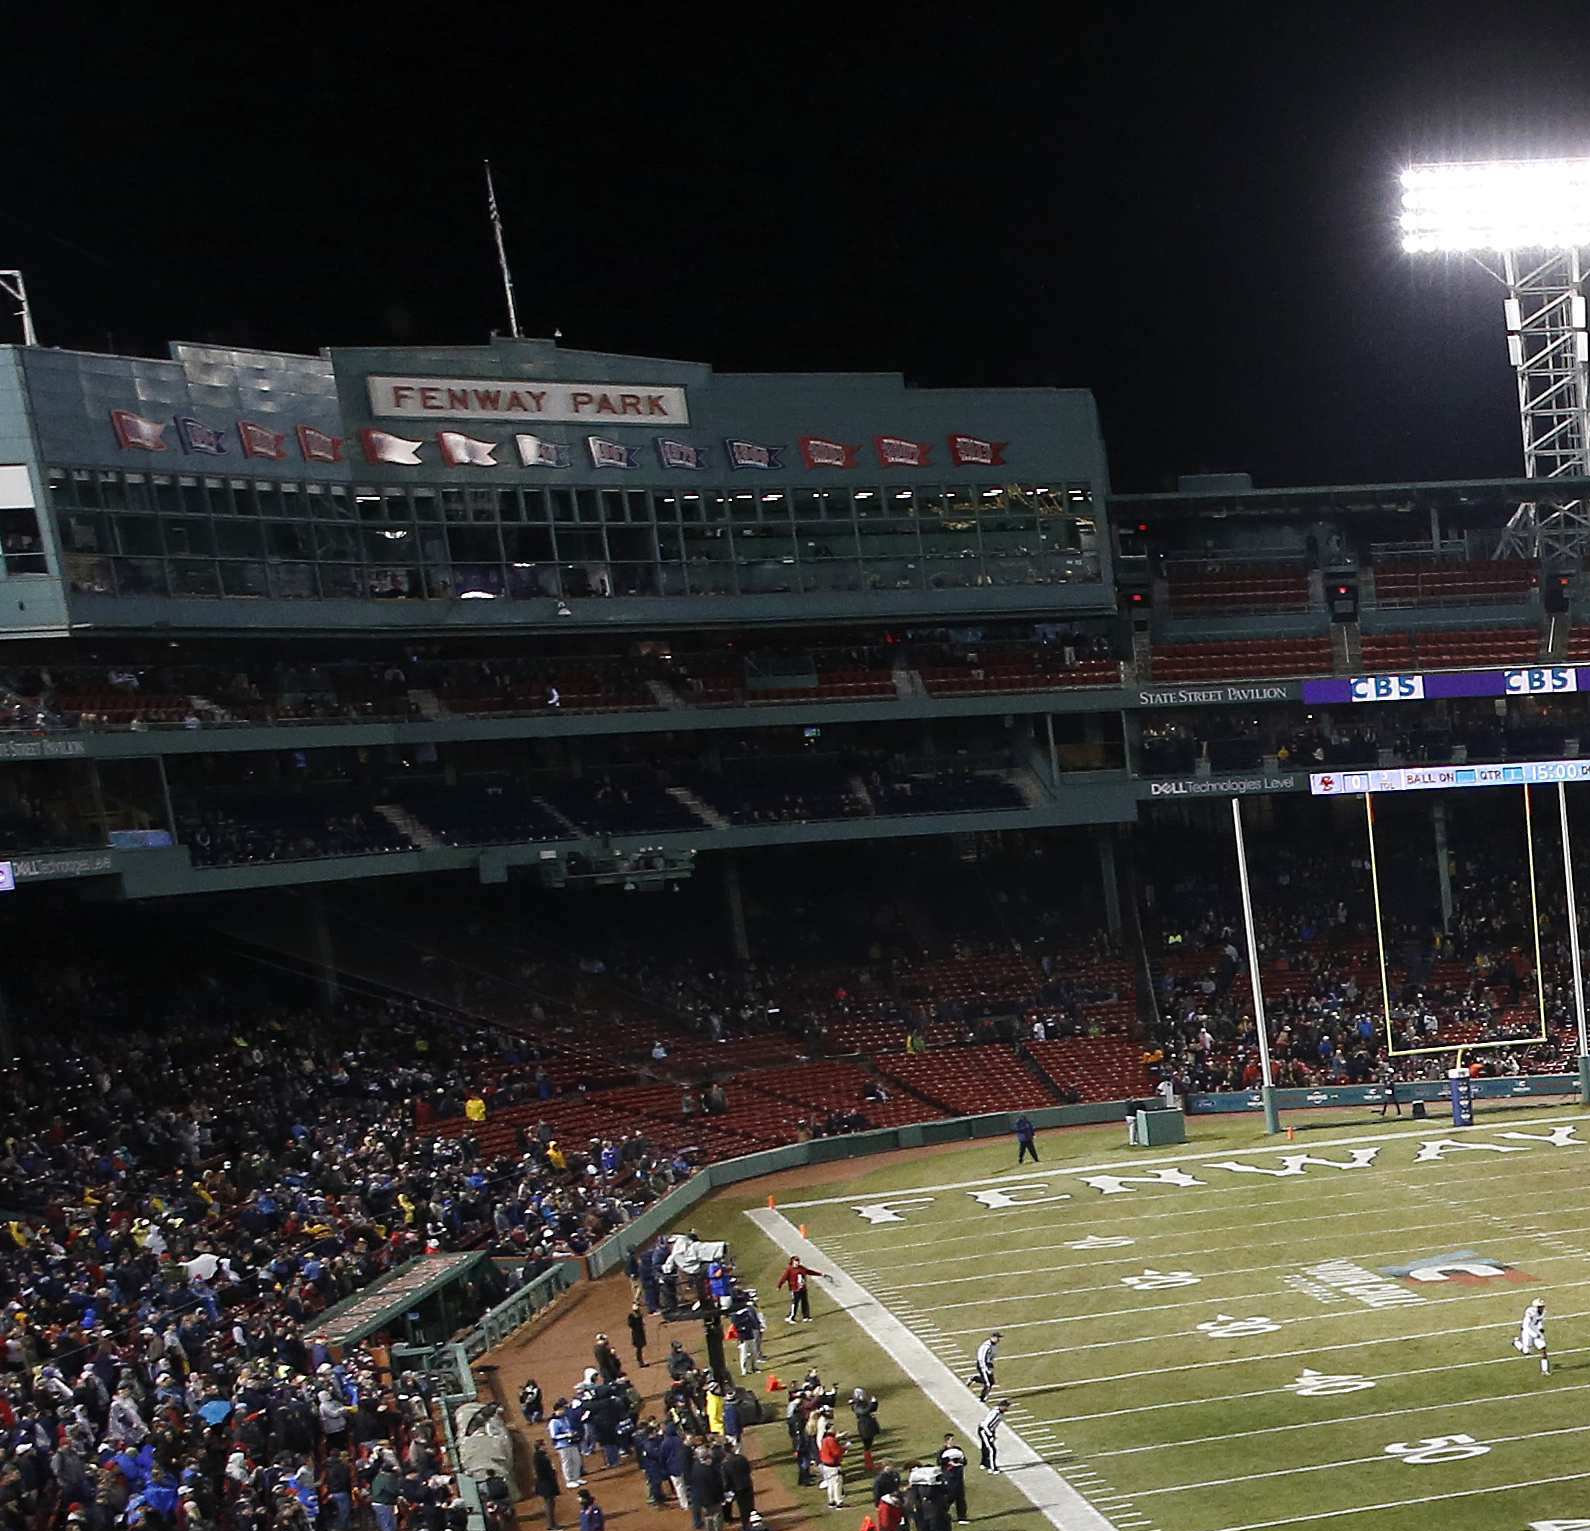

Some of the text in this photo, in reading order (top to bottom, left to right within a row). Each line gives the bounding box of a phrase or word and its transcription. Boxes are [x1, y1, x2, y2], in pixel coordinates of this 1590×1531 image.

[392, 385, 669, 417] FENWAY PARK
[1351, 675, 1416, 699] CBS
[1505, 669, 1568, 692] CBS
[1140, 687, 1287, 705] STATE STREET PAVILION
[1263, 777, 1294, 790] Level
[1407, 774, 1434, 785] BALL
[1439, 772, 1455, 784] ON
[1480, 770, 1501, 781] QTR
[1532, 764, 1577, 781] 15:00
[850, 1126, 1587, 1225] FENWAY
[1197, 1316, 1282, 1338] 30
[1283, 1374, 1377, 1396] 40
[1384, 1434, 1491, 1464] 50
